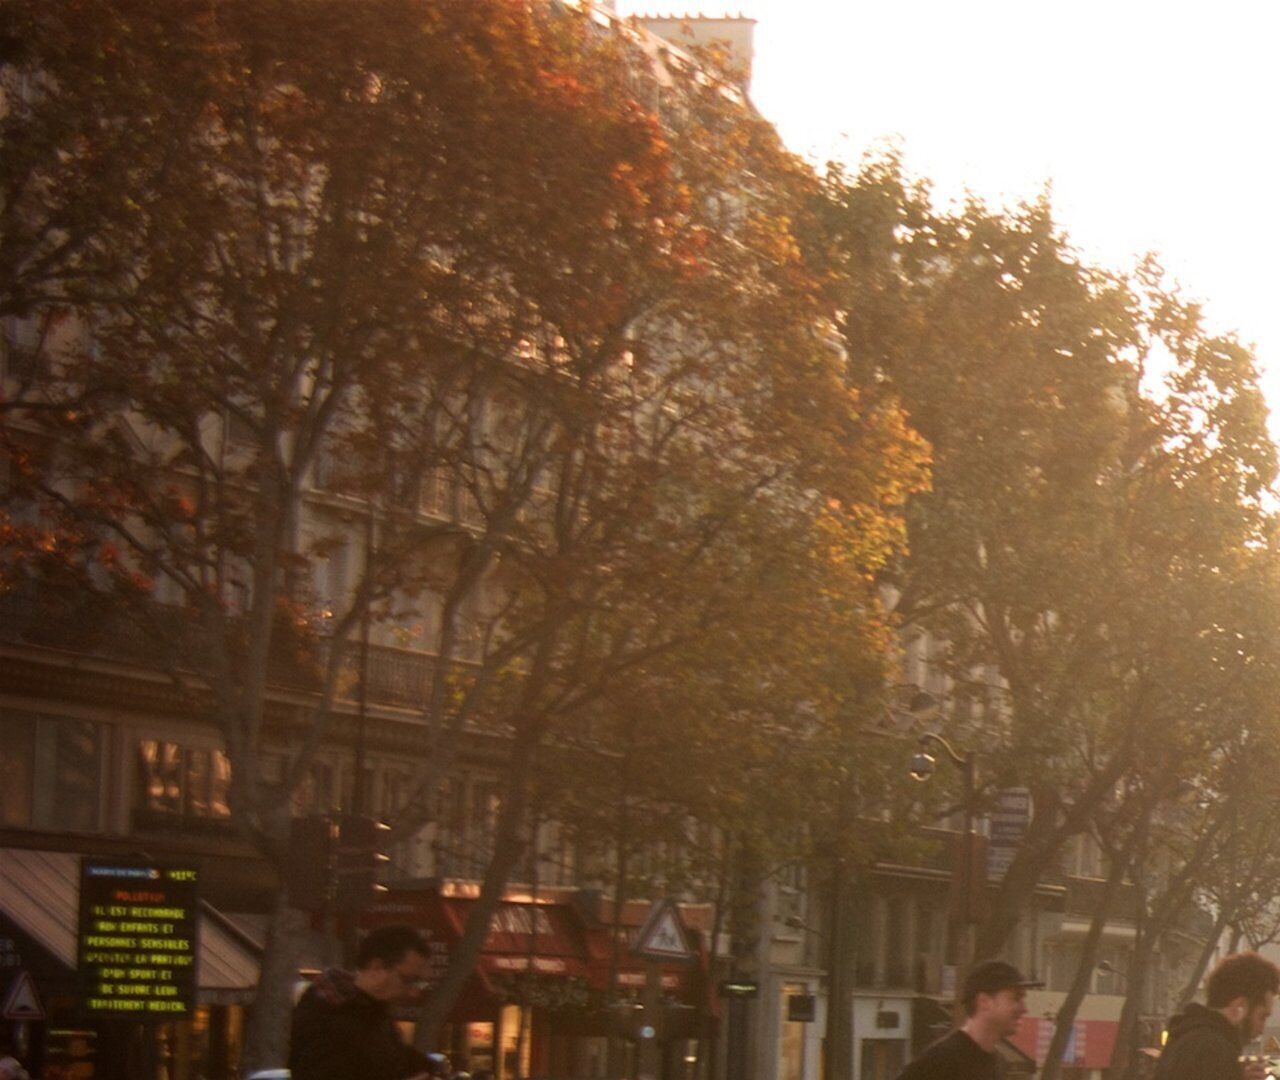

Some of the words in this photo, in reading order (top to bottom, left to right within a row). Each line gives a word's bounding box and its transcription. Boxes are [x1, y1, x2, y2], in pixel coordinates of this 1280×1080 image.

[110, 906, 127, 917] EST
[120, 922, 159, 933] ENFANTS
[163, 924, 174, 934] ET
[87, 936, 136, 949] PERSONNES
[141, 938, 189, 950] SENSIBLES
[129, 969, 157, 979] SPORT
[161, 970, 172, 980] ET
